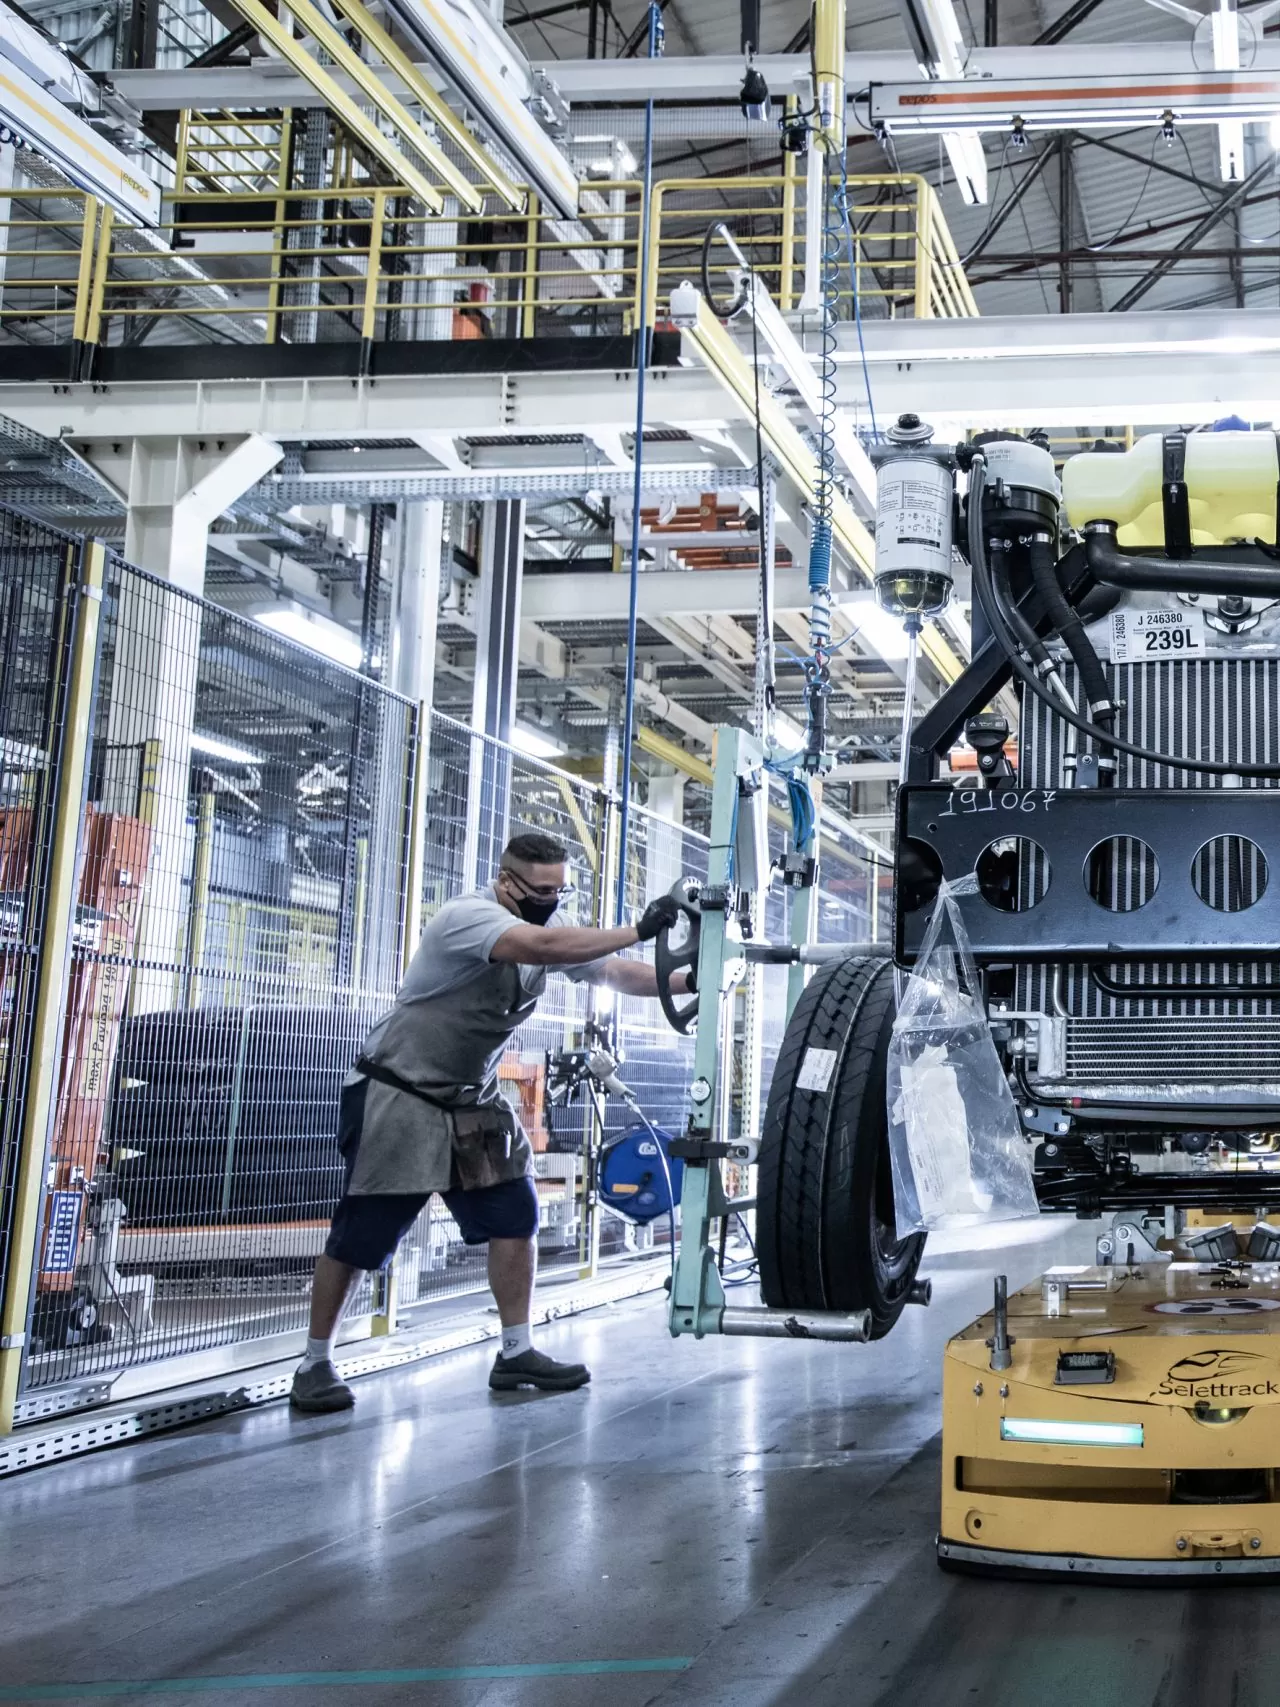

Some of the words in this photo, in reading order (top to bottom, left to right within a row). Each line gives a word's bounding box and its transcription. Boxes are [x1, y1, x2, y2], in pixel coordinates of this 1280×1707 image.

[899, 93, 937, 106] eepos
[1115, 614, 1126, 640] 246380
[1138, 615, 1144, 626] J
[1146, 613, 1183, 625] 246380
[1145, 628, 1199, 651] 239L
[938, 789, 1057, 816] 191067
[1158, 1380, 1279, 1398] Selettrack
